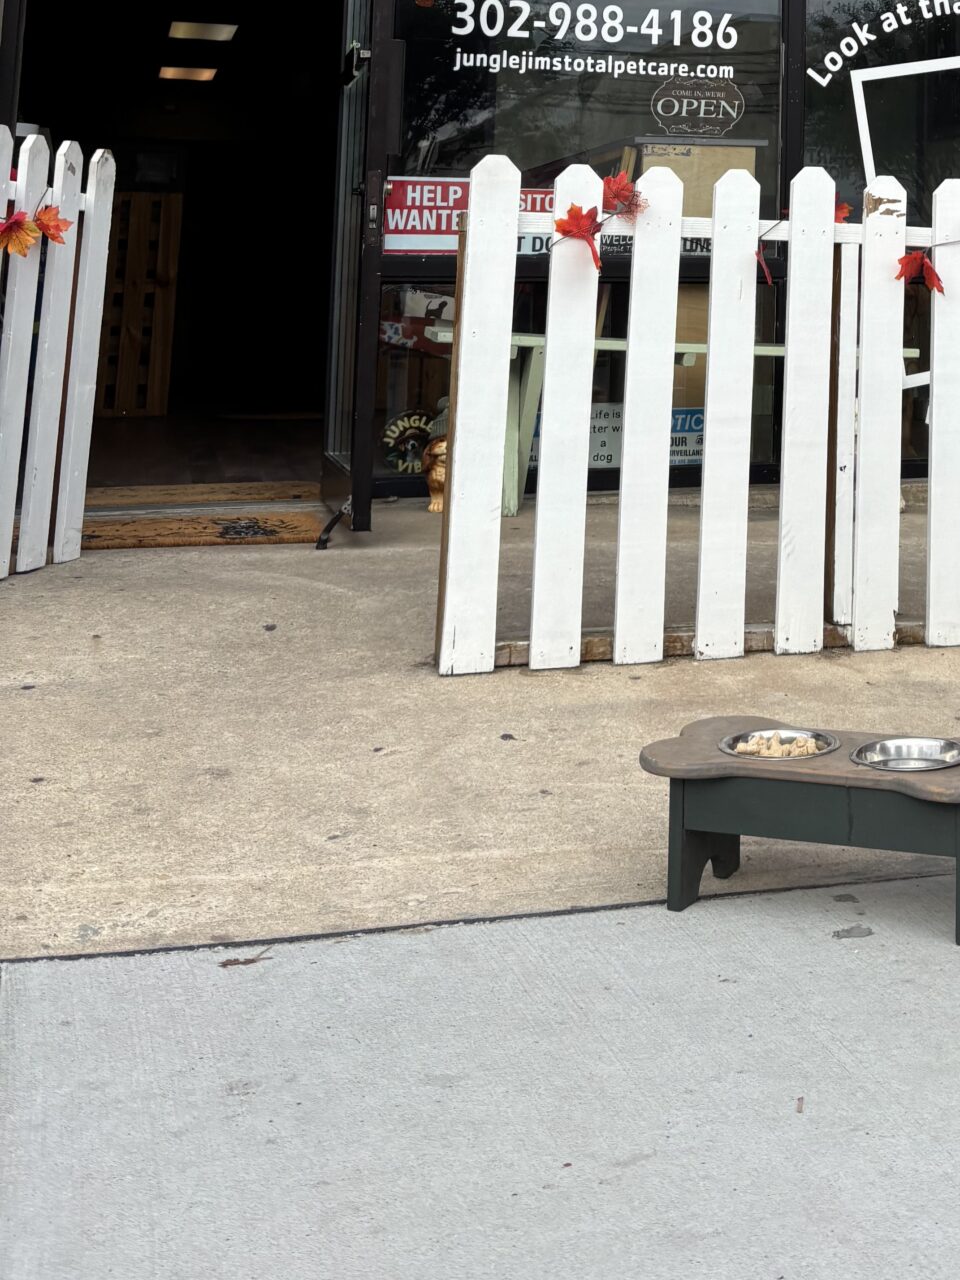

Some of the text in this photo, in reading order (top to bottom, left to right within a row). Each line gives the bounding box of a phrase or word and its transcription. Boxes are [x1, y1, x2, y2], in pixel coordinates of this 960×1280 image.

[806, 22, 877, 88] Look
[879, 1, 913, 34] at
[453, 48, 735, 79] junglejimstotalpetcare.com
[671, 89, 693, 97] COME
[656, 97, 741, 119] OPEN
[406, 184, 463, 208] HELP
[386, 208, 460, 231] WANTE
[612, 408, 622, 419] is
[671, 413, 704, 431] TIC
[600, 440, 607, 448] a
[592, 452, 613, 464] dog
